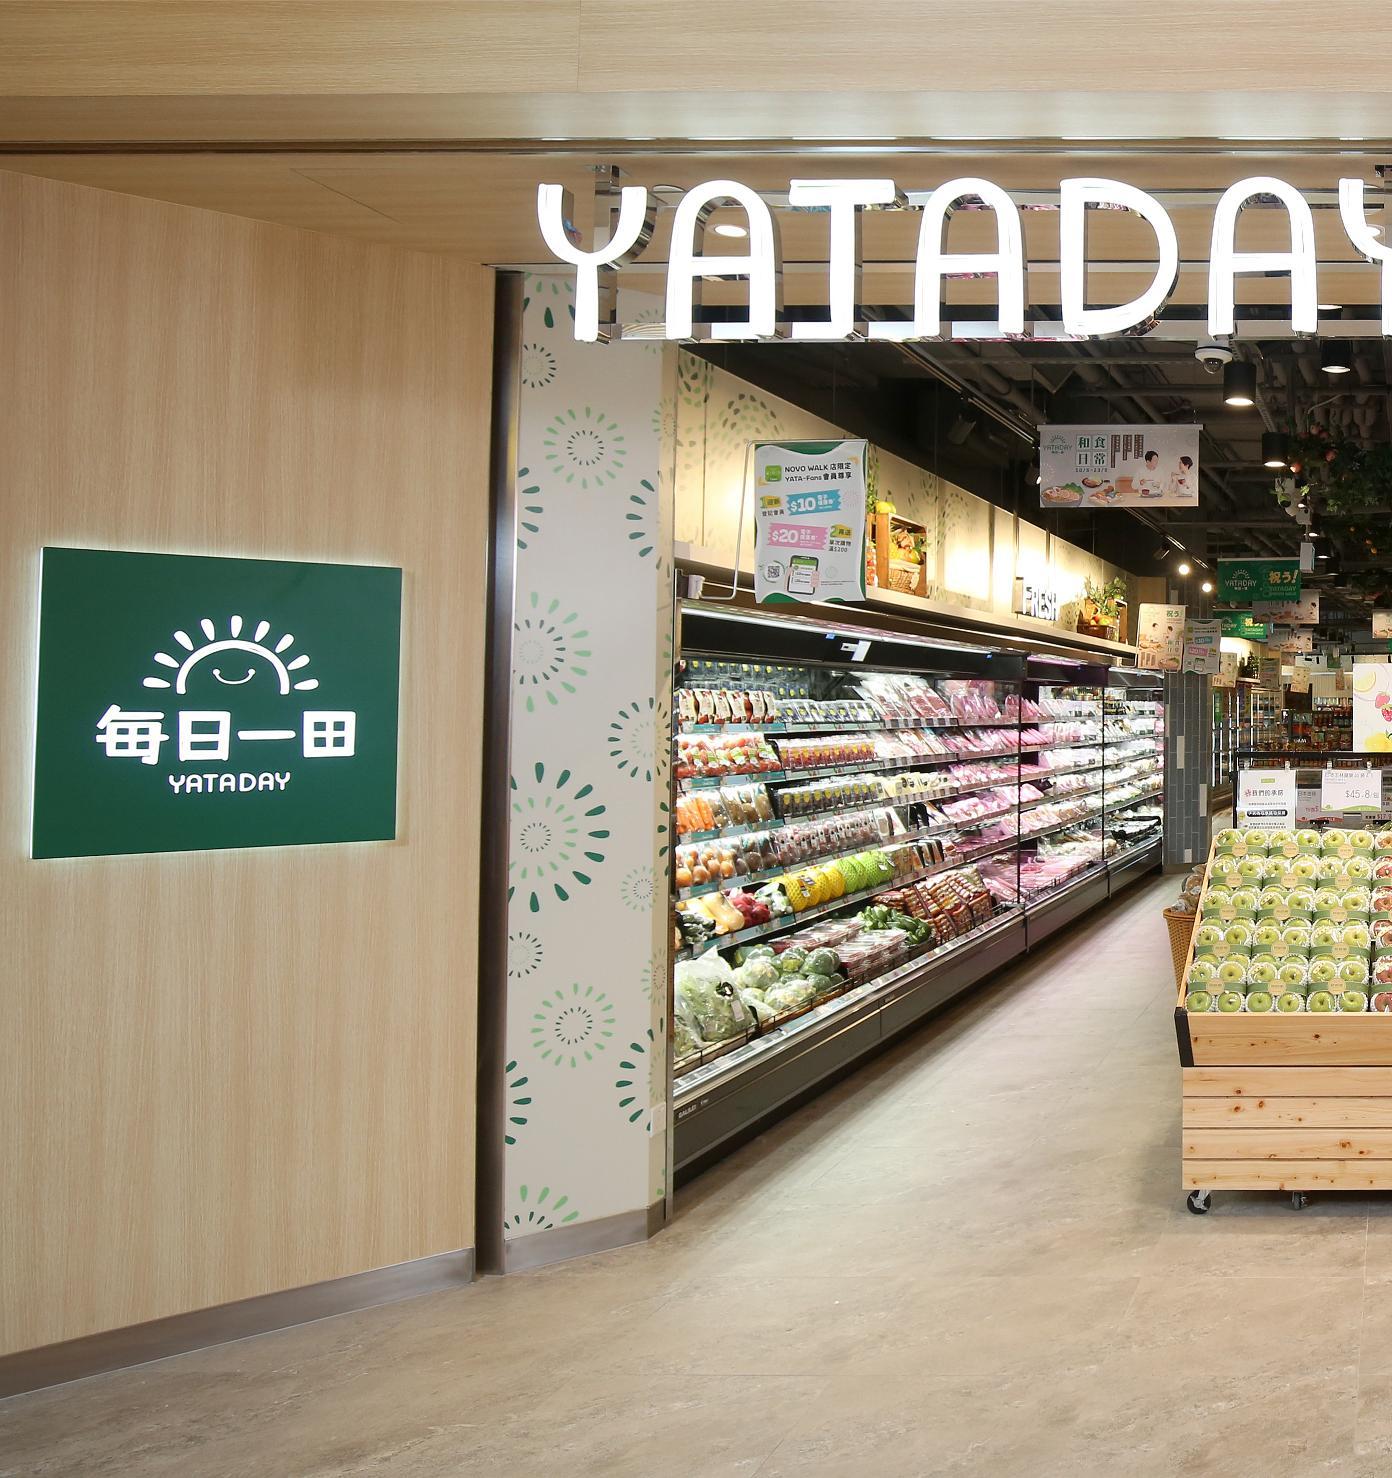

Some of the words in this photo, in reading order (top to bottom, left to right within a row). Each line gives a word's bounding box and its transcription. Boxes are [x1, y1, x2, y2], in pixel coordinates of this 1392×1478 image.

[784, 465, 806, 473] NOVO
[790, 497, 816, 513] $10
[772, 528, 799, 543] $20
[1225, 579, 1257, 587] YATADAY
[168, 771, 291, 794] YATADAY
